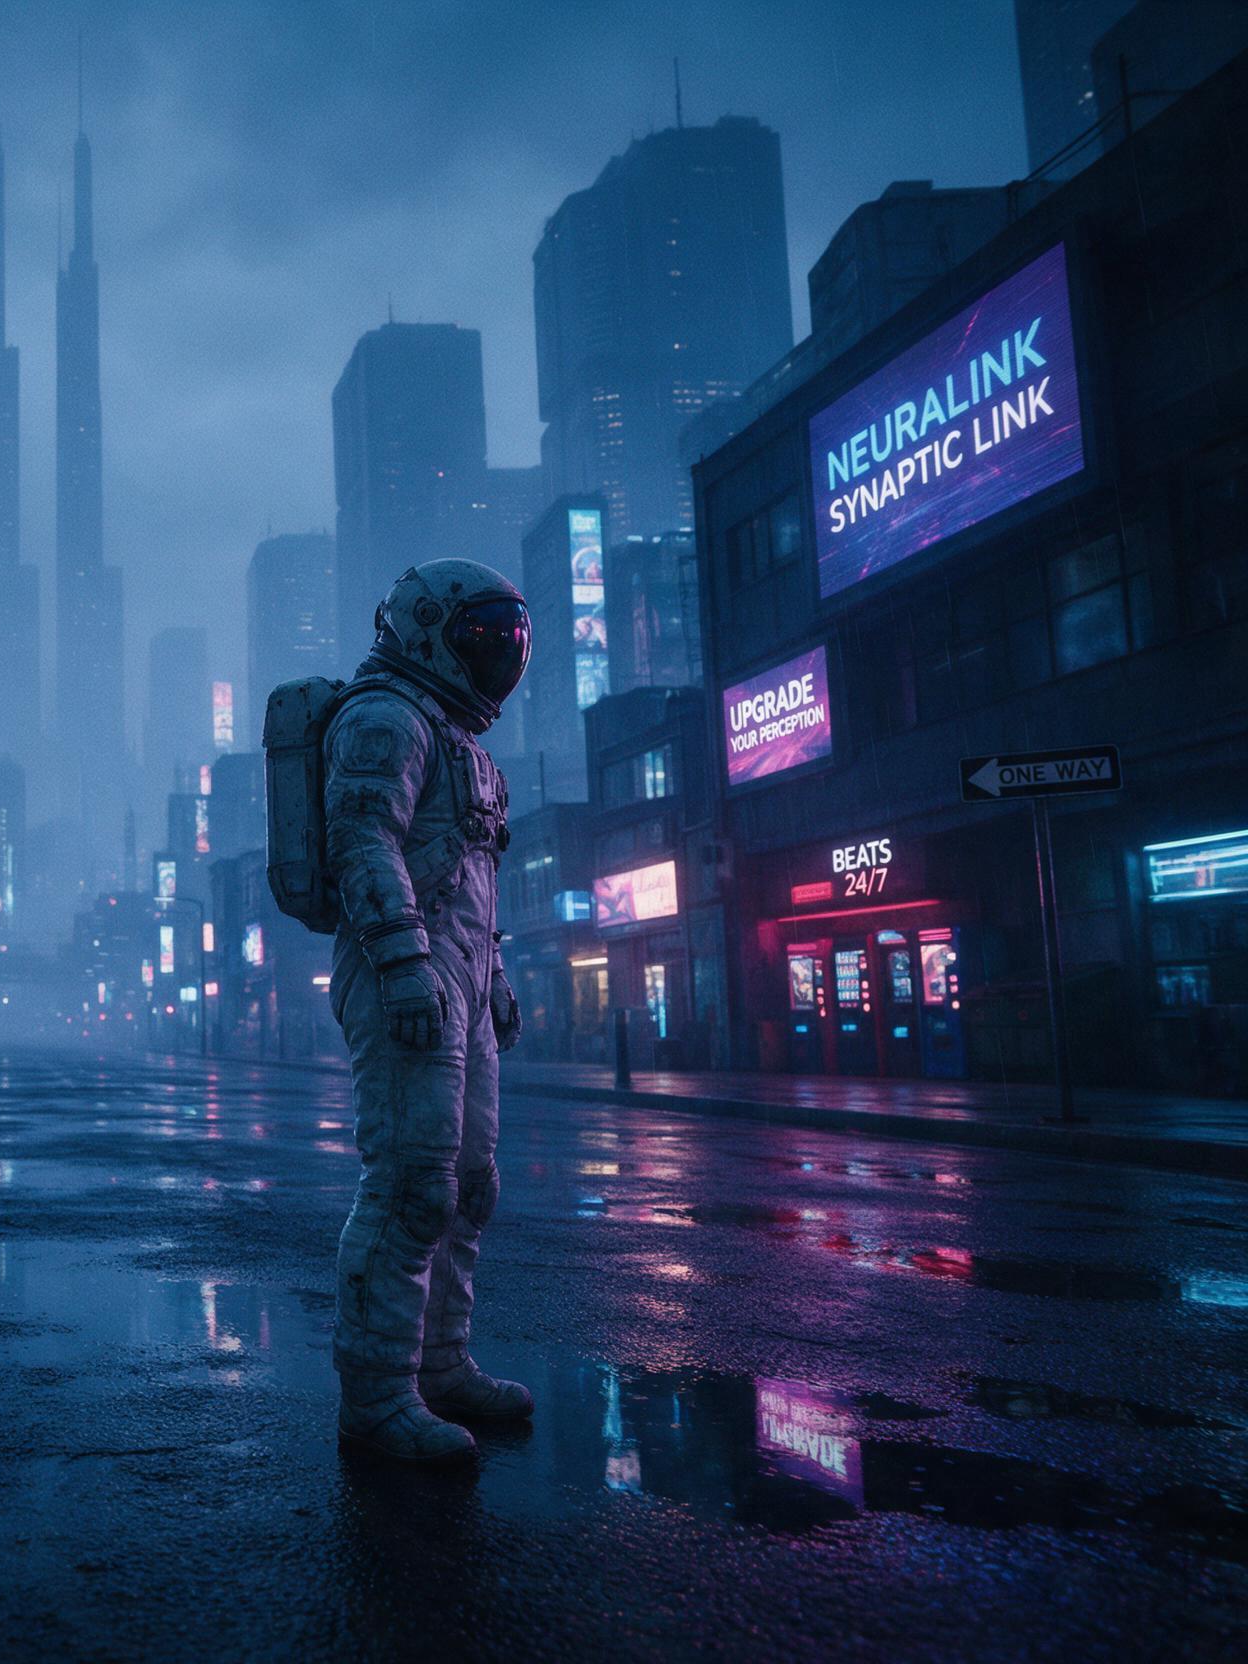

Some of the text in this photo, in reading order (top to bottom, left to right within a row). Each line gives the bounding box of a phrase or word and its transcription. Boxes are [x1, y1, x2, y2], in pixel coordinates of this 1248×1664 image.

[827, 316, 1047, 491] NEURALINK
[829, 376, 1054, 534] SYNAPTIC LINK
[730, 673, 815, 732] UPGRADE
[730, 703, 825, 753] YOUR PERCEPTION
[1000, 758, 1107, 784] ONE WAY
[832, 838, 892, 873] BEATS
[844, 867, 888, 897] 24/7
